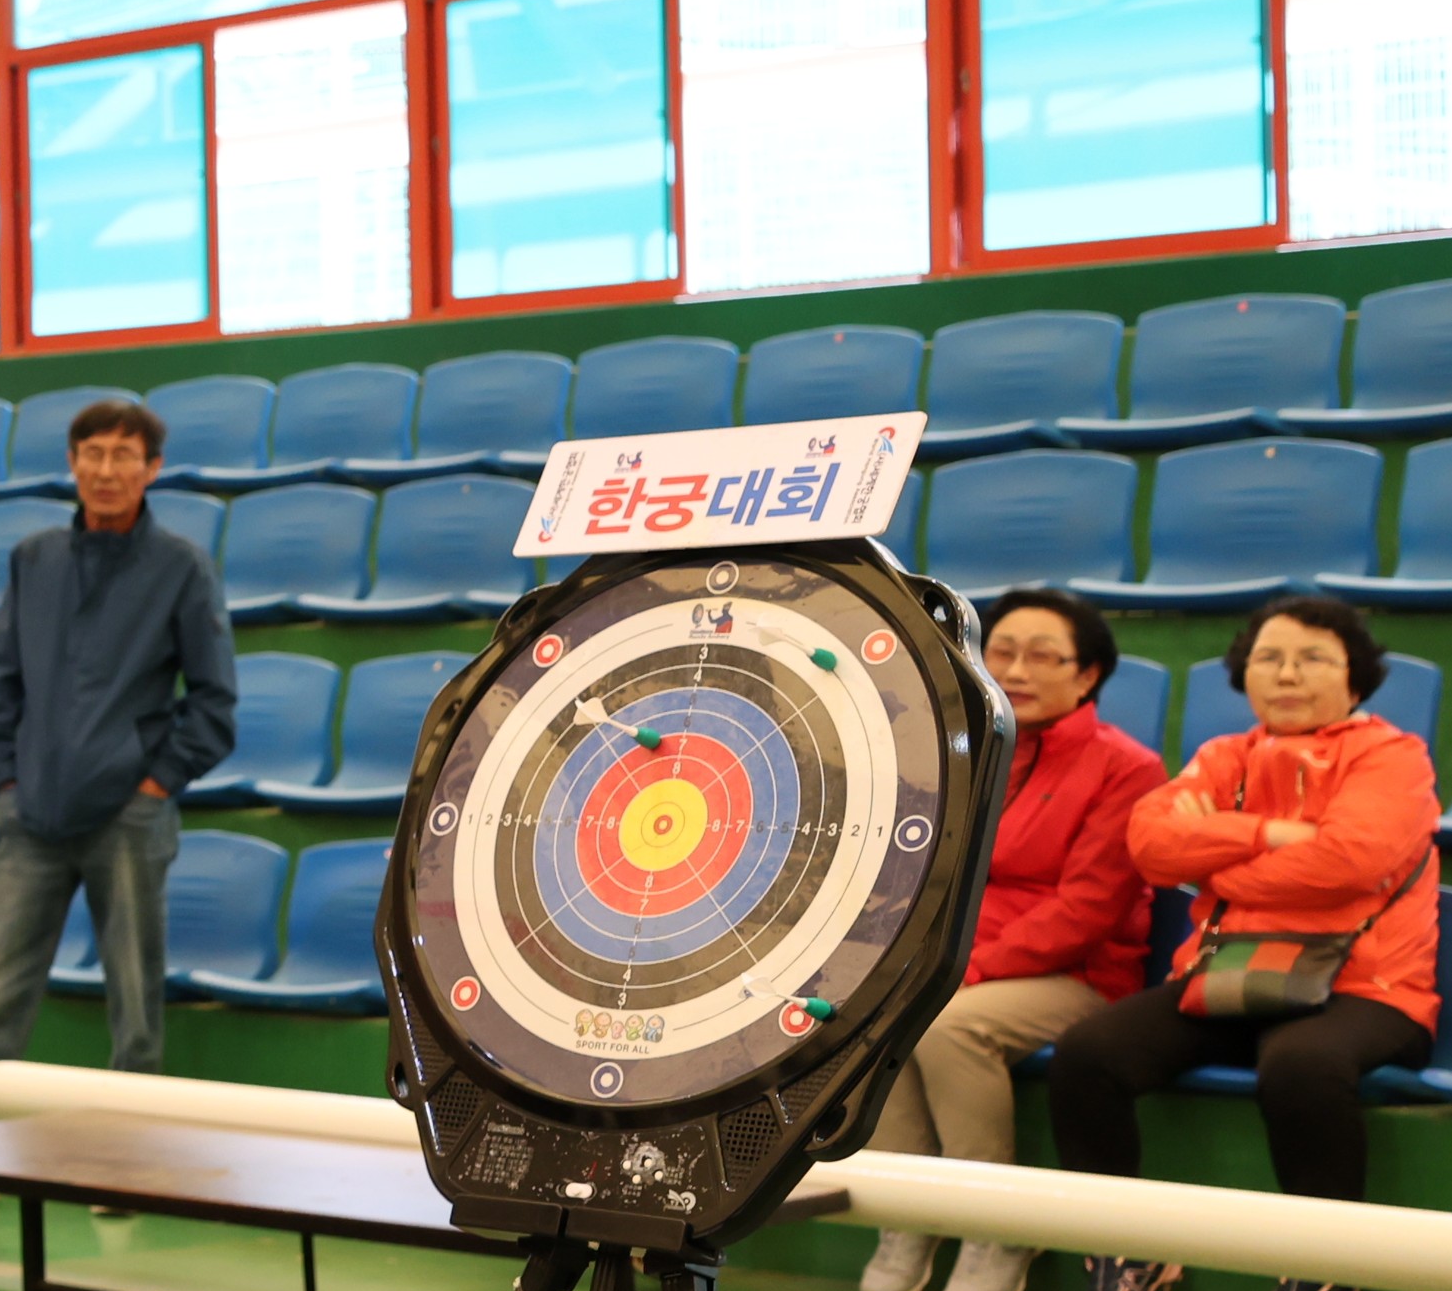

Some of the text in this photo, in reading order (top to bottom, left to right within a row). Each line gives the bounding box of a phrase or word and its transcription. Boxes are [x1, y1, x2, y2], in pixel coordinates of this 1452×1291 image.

[585, 462, 842, 536] 한궁대회
[699, 646, 709, 660] 3
[693, 668, 703, 682] 4
[679, 738, 688, 752] 7
[672, 762, 682, 775] 8
[467, 814, 474, 825] 1
[485, 814, 493, 826] 2
[503, 813, 512, 827] 3
[523, 813, 532, 827] 4
[586, 815, 595, 828] 7
[606, 815, 616, 829] 8
[711, 819, 721, 832] 8
[735, 820, 745, 833] 7
[801, 822, 811, 835] 4
[828, 823, 837, 837] 3
[851, 824, 860, 837] 2
[876, 826, 884, 838] 1
[645, 875, 653, 888] 8
[641, 898, 649, 911] 7
[622, 967, 632, 982] 4
[617, 991, 627, 1006] 3
[575, 1039, 650, 1055] SPORT FOR ALL
